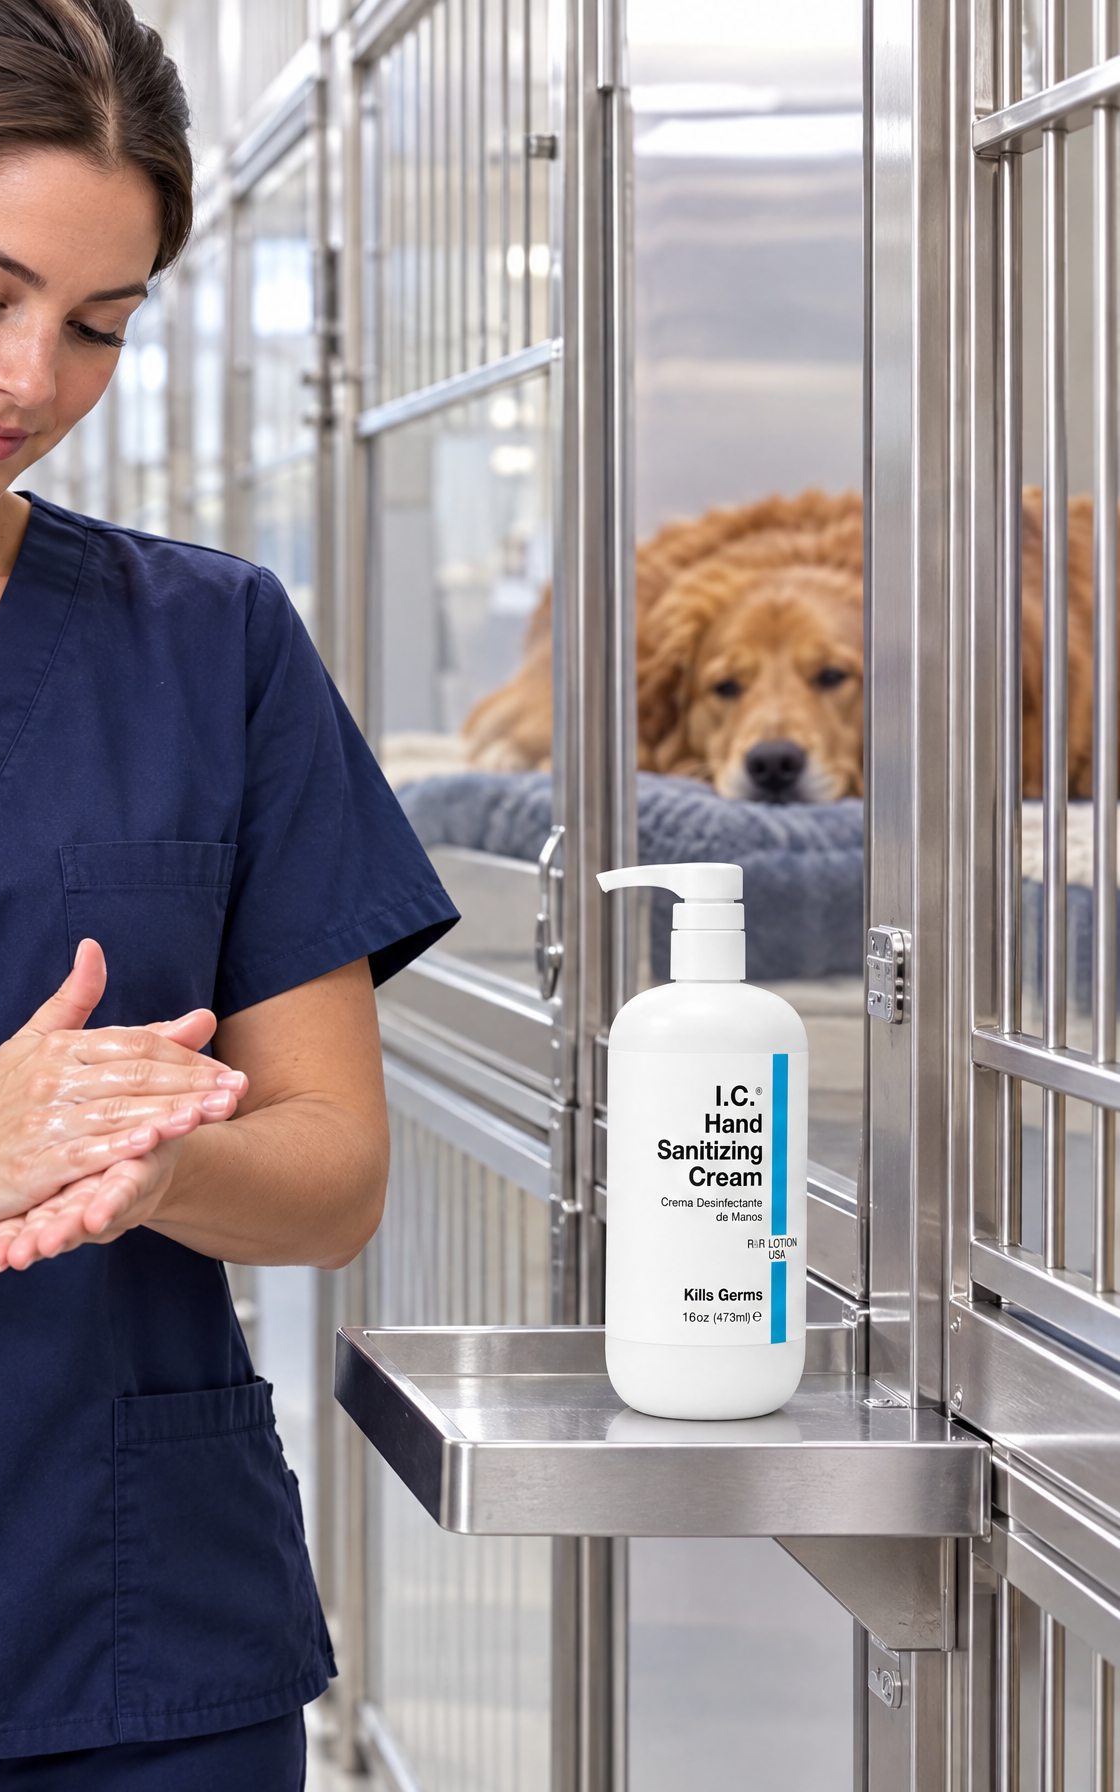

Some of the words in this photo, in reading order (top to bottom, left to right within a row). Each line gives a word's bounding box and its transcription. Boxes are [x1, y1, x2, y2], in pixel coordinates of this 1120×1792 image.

[705, 1113, 763, 1134] Hand
[657, 1139, 763, 1165] Sanitizing
[689, 1166, 763, 1187] Cream
[661, 1197, 693, 1208] Crema
[697, 1197, 763, 1209] Desinfectante
[716, 1212, 728, 1221] de
[732, 1212, 763, 1222] Manos
[768, 1238, 797, 1249] LOTION
[768, 1250, 786, 1259] USA
[684, 1288, 714, 1301] Kills
[718, 1288, 763, 1301] Germs
[683, 1312, 710, 1323] 16oz
[713, 1312, 751, 1325] (473ml)
